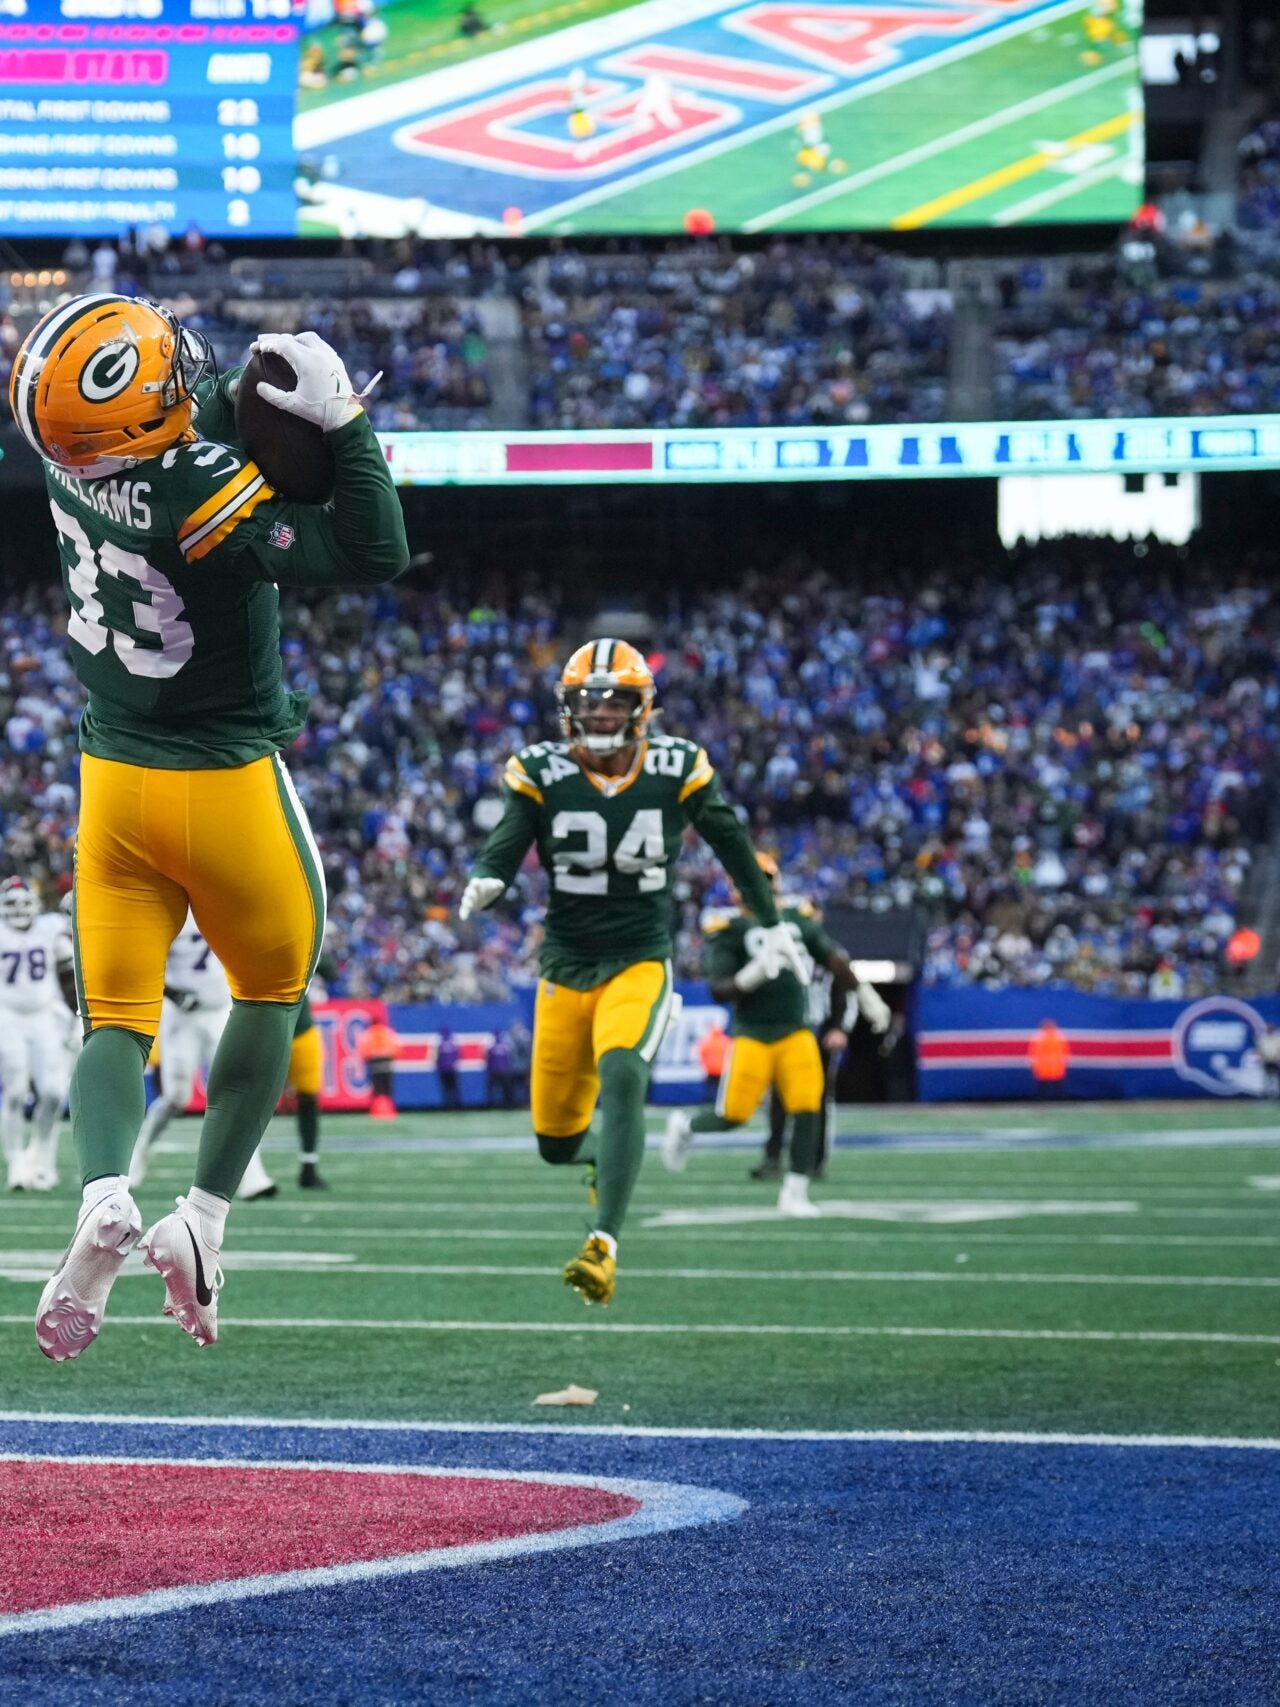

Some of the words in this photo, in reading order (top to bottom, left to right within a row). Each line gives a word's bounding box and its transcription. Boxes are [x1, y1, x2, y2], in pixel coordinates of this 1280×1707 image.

[79, 341, 139, 402] G
[50, 498, 195, 678] 33
[552, 808, 669, 895] 24
[1, 948, 47, 985] 78
